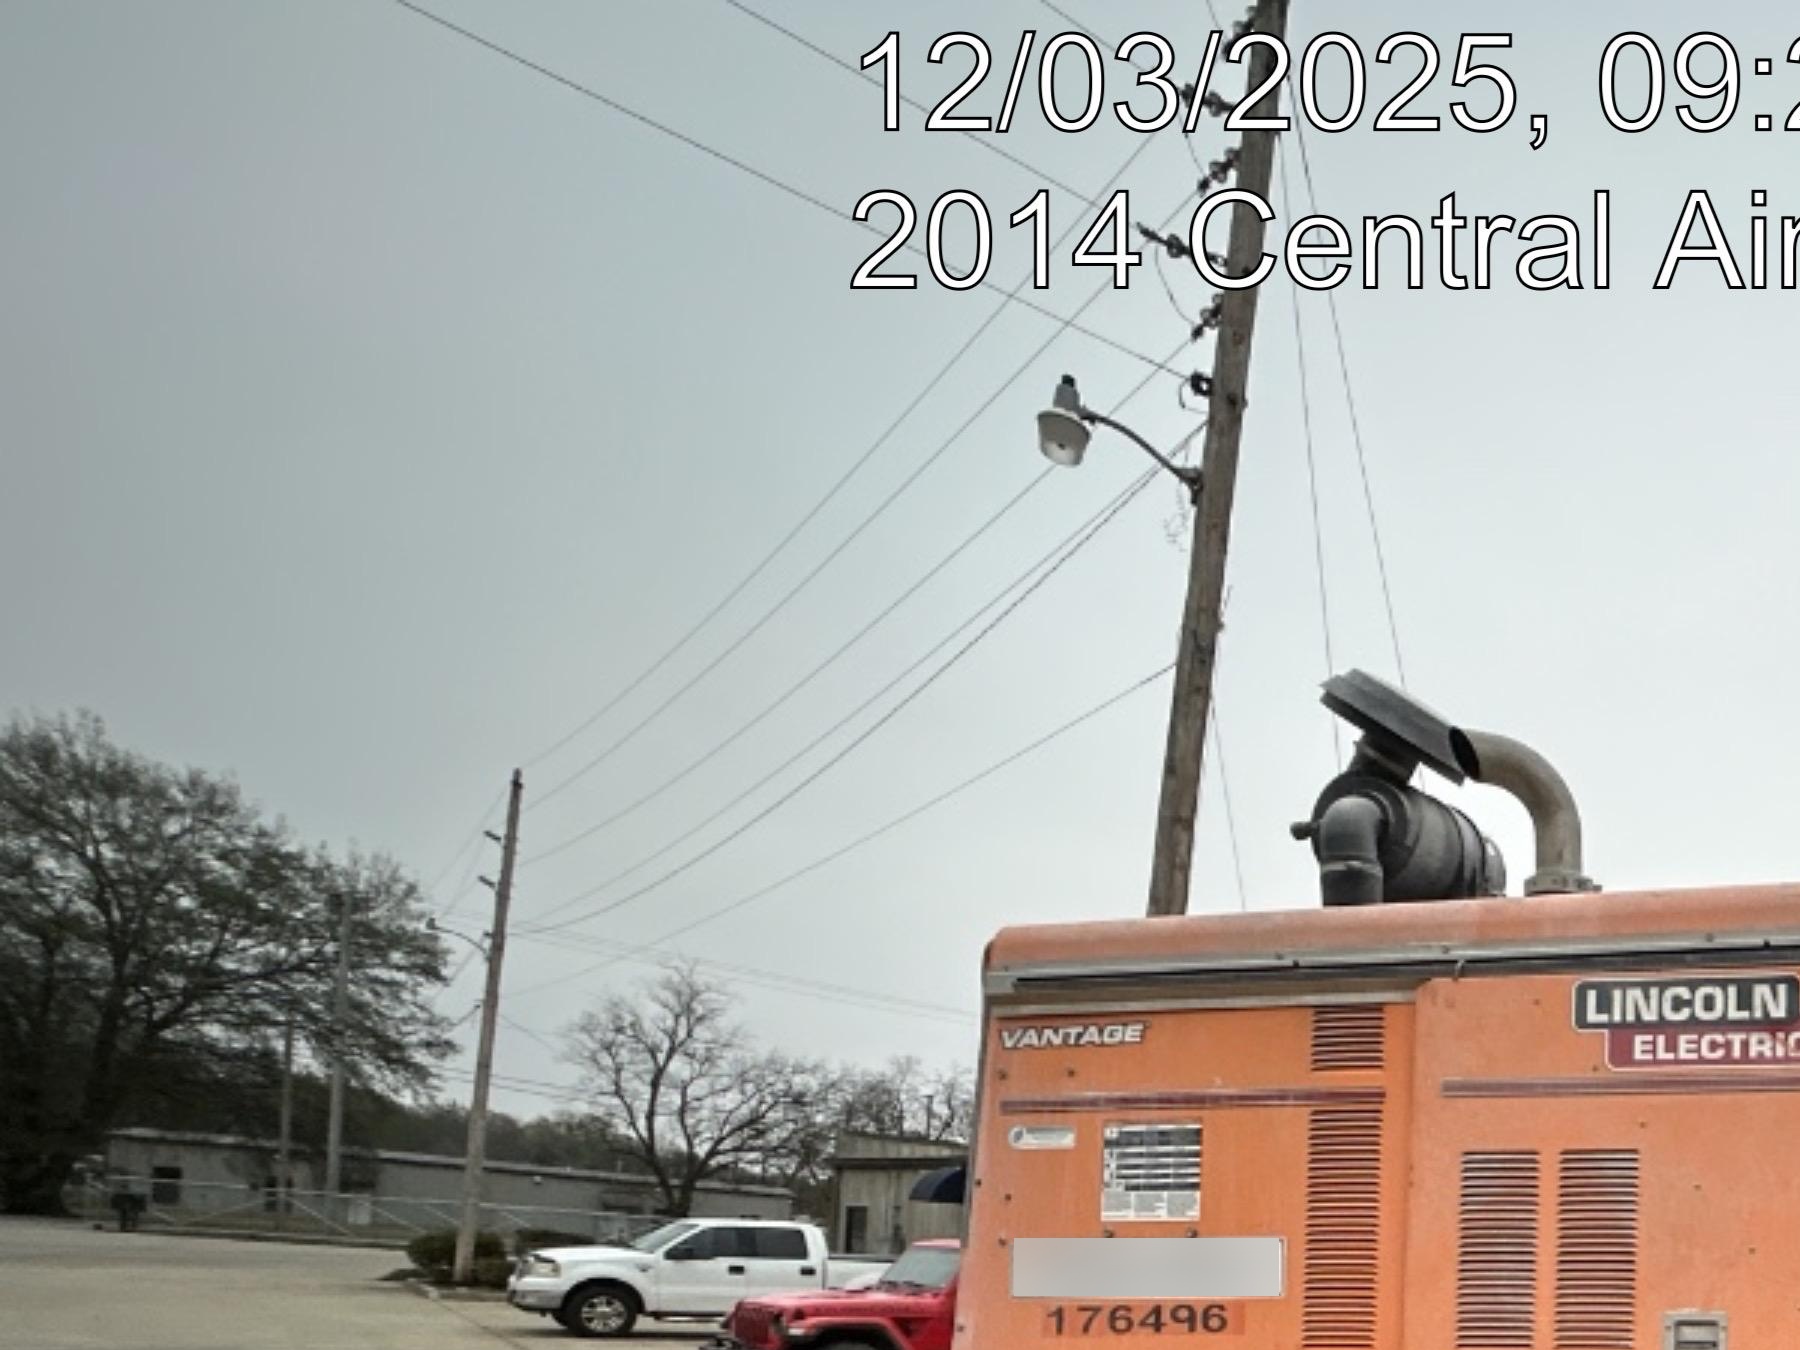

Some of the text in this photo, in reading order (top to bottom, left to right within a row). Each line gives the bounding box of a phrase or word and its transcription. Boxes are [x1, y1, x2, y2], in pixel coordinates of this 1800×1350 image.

[1586, 984, 1788, 1023] LINCOLN
[1001, 1023, 1144, 1049] VANTAGE
[1047, 1304, 1228, 1335] 176496
